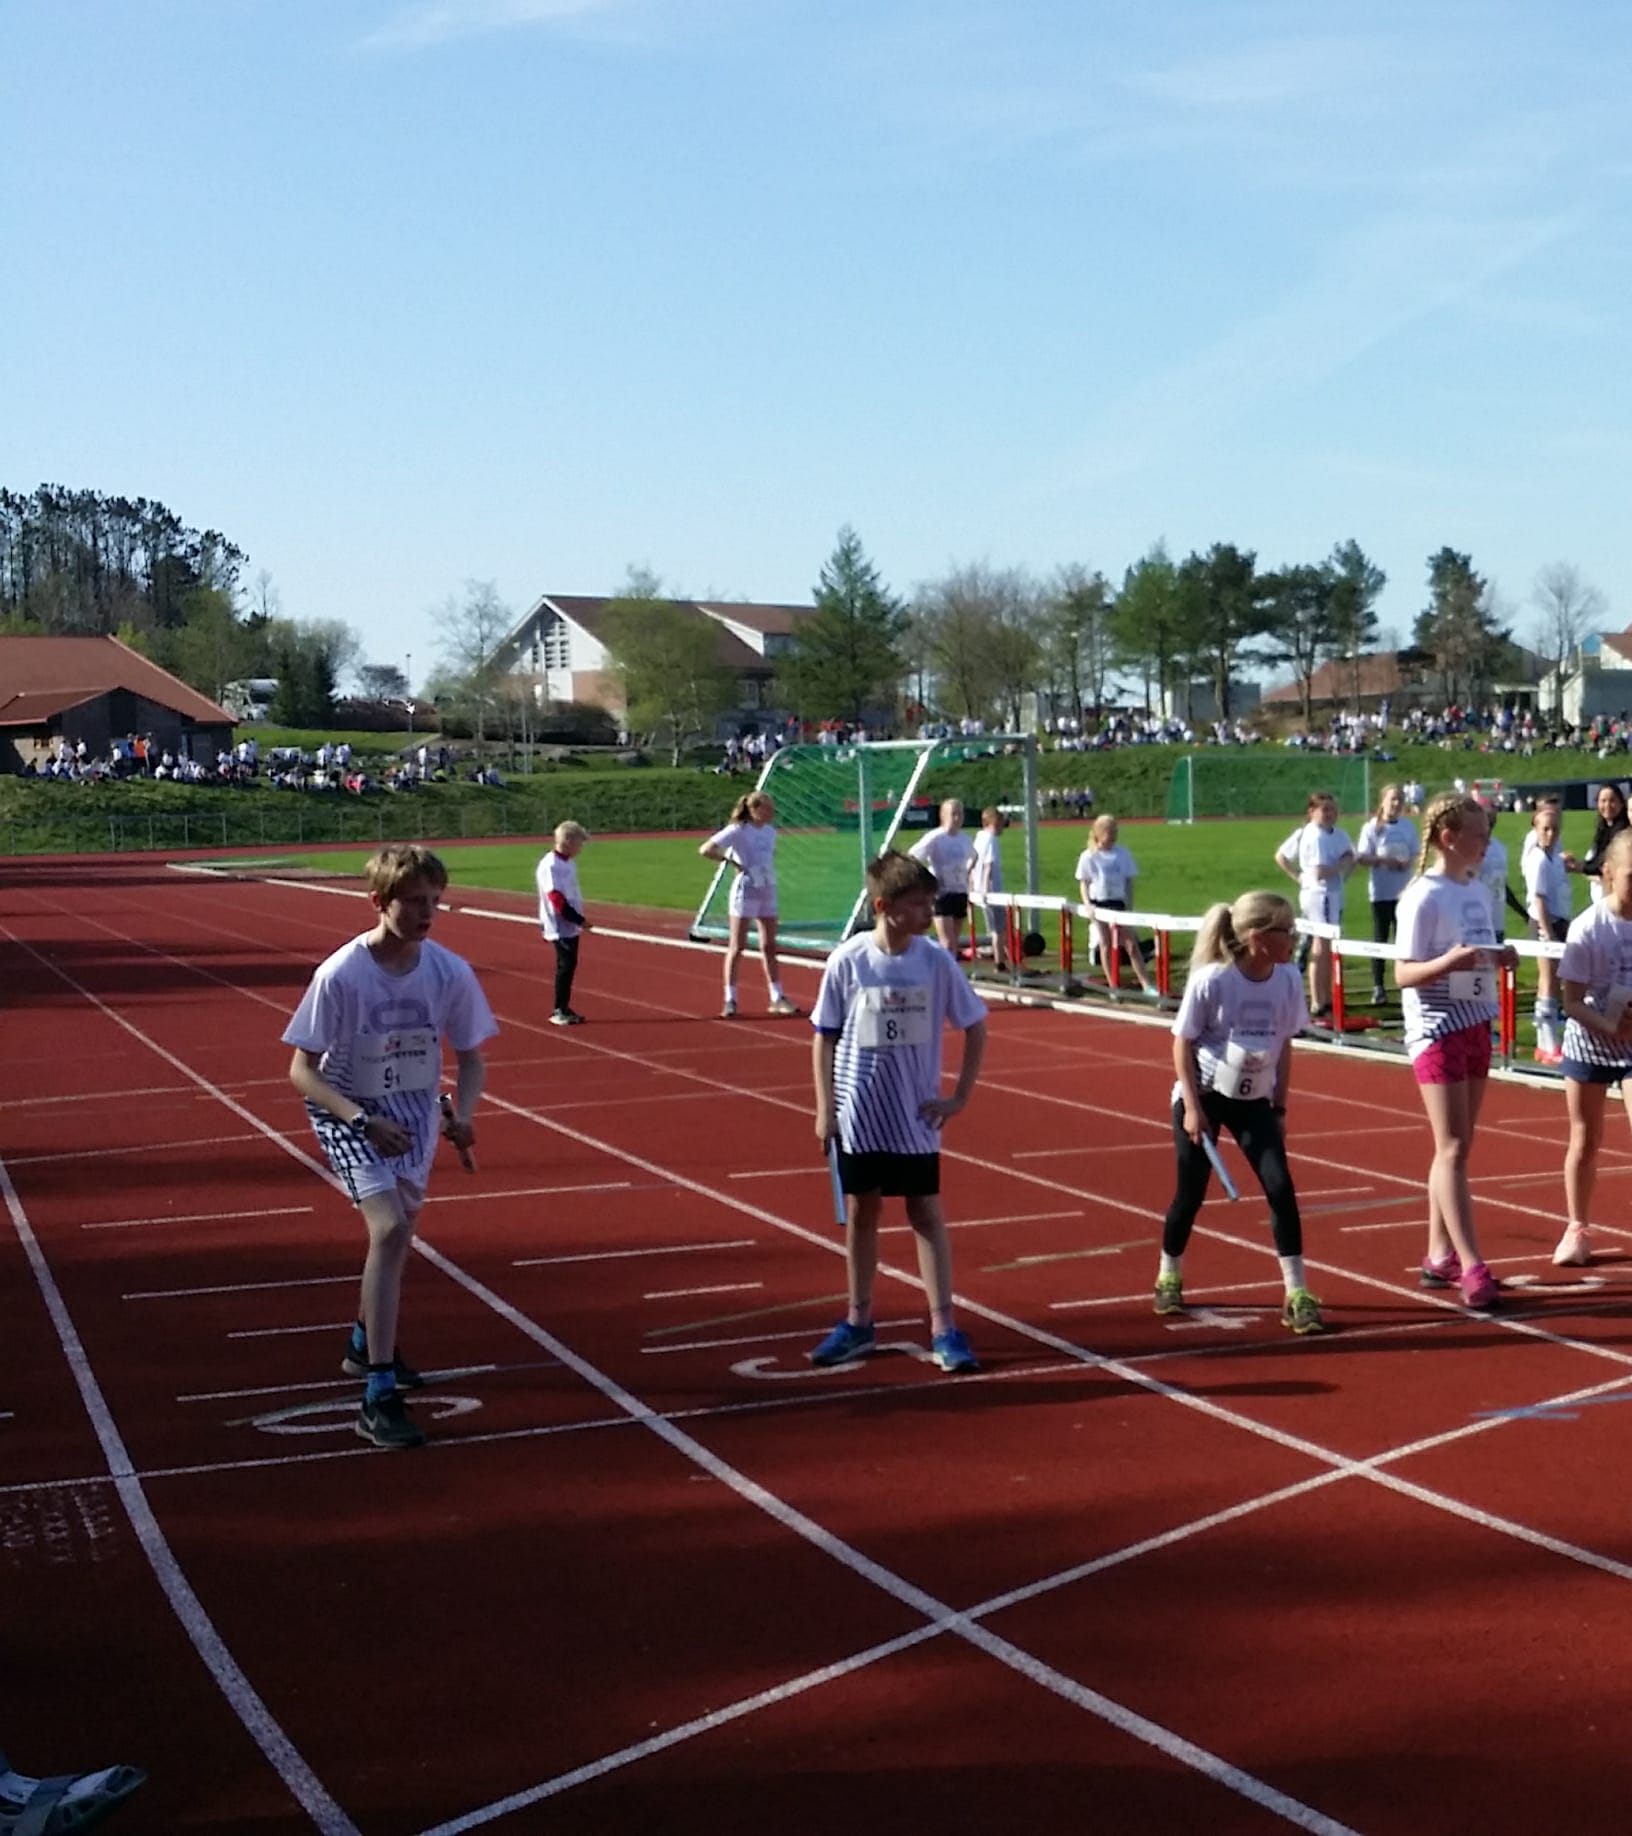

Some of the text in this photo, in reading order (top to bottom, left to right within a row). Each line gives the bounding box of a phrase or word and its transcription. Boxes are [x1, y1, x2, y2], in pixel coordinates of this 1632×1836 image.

[1473, 977, 1483, 996] 5
[886, 1019, 898, 1040] 8
[384, 1066, 394, 1089] 9
[1240, 1078, 1253, 1096] 6
